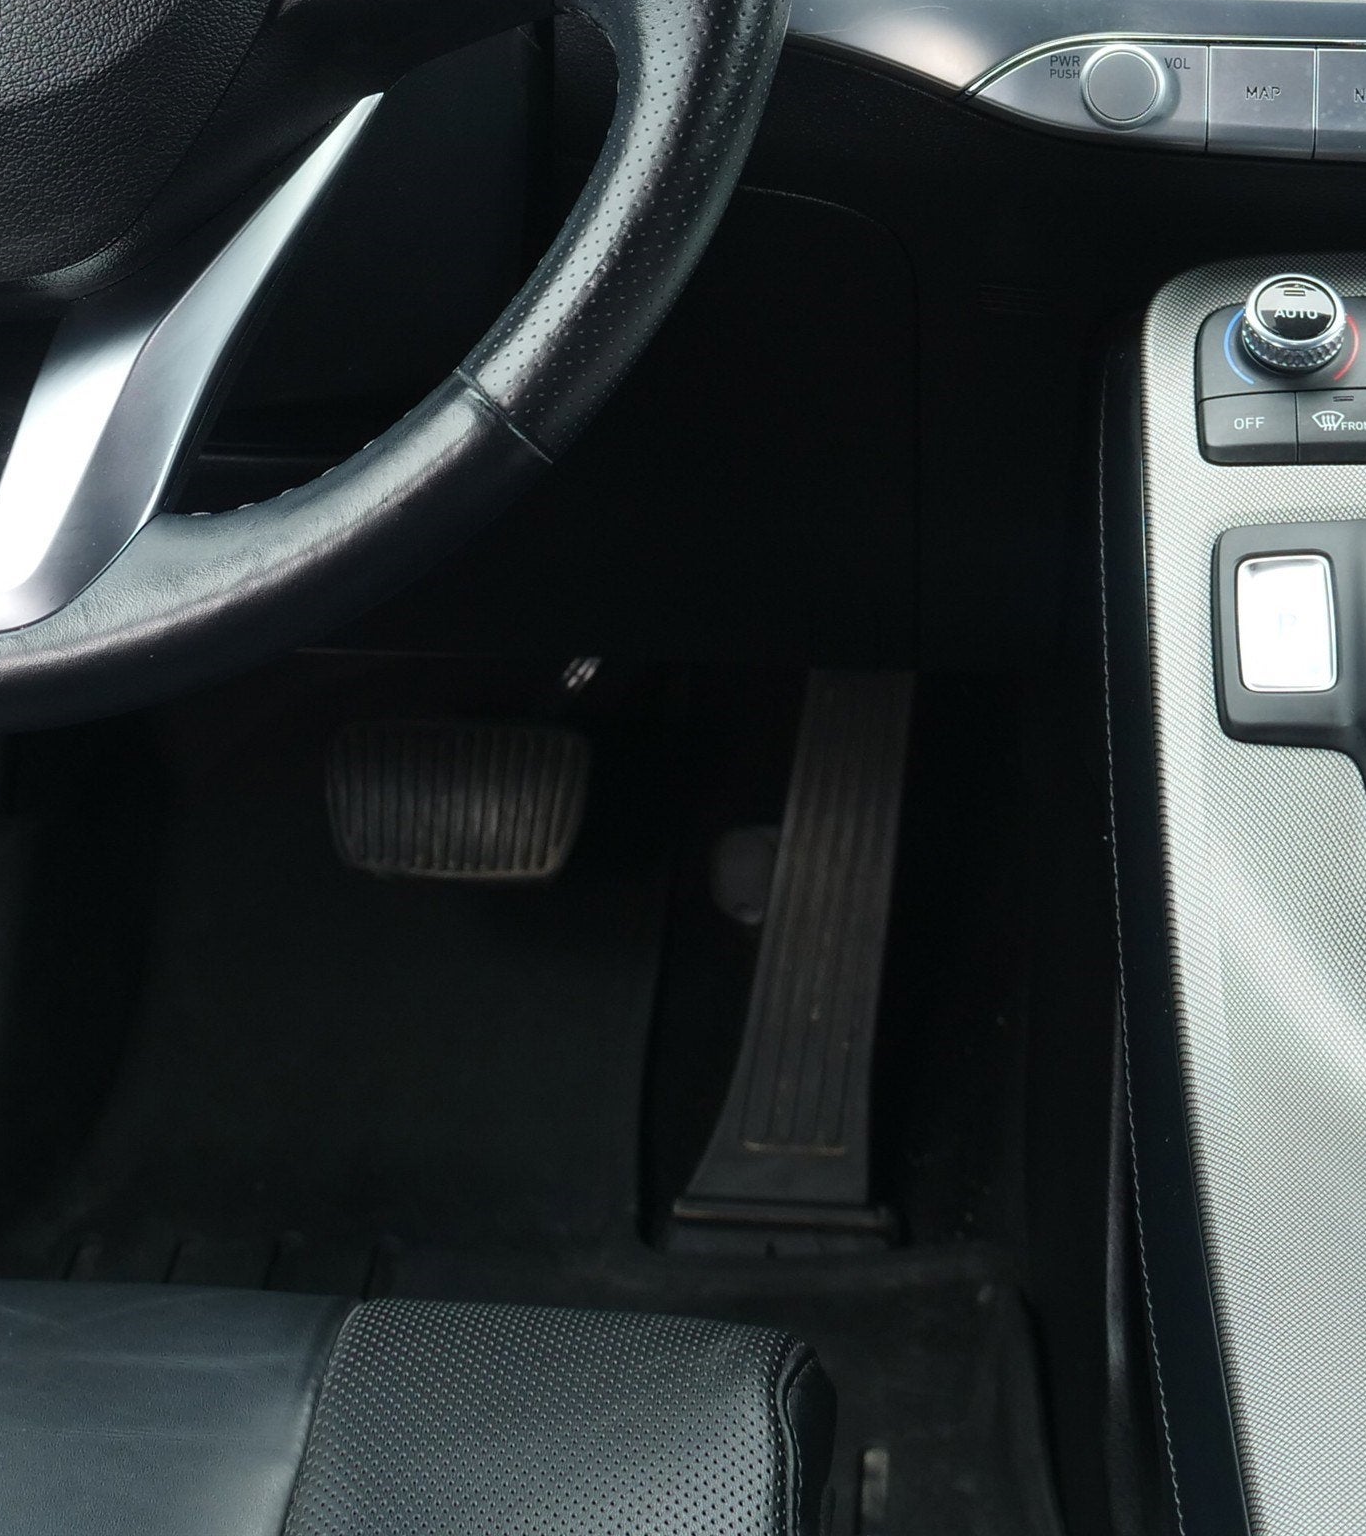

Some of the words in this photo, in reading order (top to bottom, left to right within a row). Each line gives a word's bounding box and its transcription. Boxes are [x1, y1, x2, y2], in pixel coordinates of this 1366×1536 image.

[1049, 55, 1081, 67] PWR
[1164, 57, 1191, 70] VOL
[1049, 68, 1081, 80] PUSH
[1245, 86, 1282, 102] MAP
[1274, 306, 1319, 320] AUTO
[1233, 416, 1265, 431] OFF
